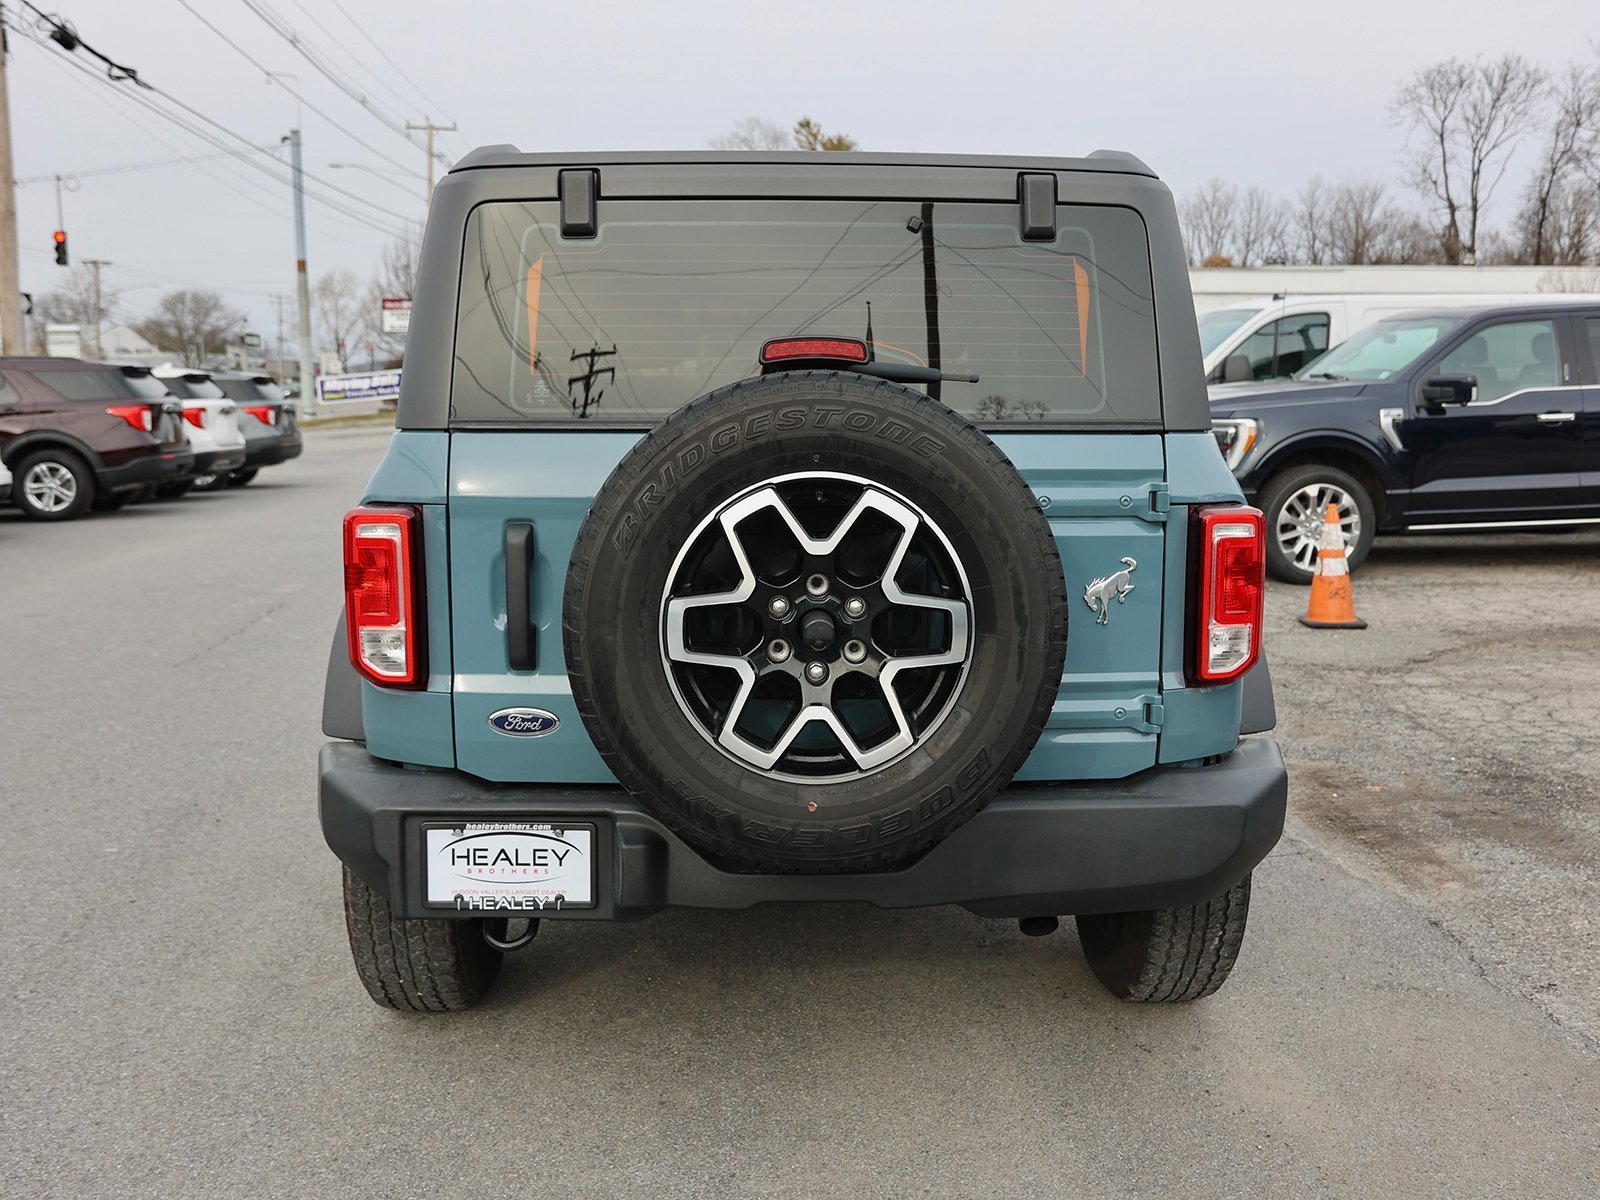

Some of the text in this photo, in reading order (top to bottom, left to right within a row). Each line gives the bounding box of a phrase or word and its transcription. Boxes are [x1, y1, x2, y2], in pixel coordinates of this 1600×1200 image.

[611, 405, 945, 553] BRIDGESTONE
[504, 713, 542, 731] Ford
[743, 745, 993, 848] DUELER
[465, 822, 552, 831] healeybrothers.com
[451, 848, 571, 867] HEALEY
[469, 896, 549, 910] HEALEY
